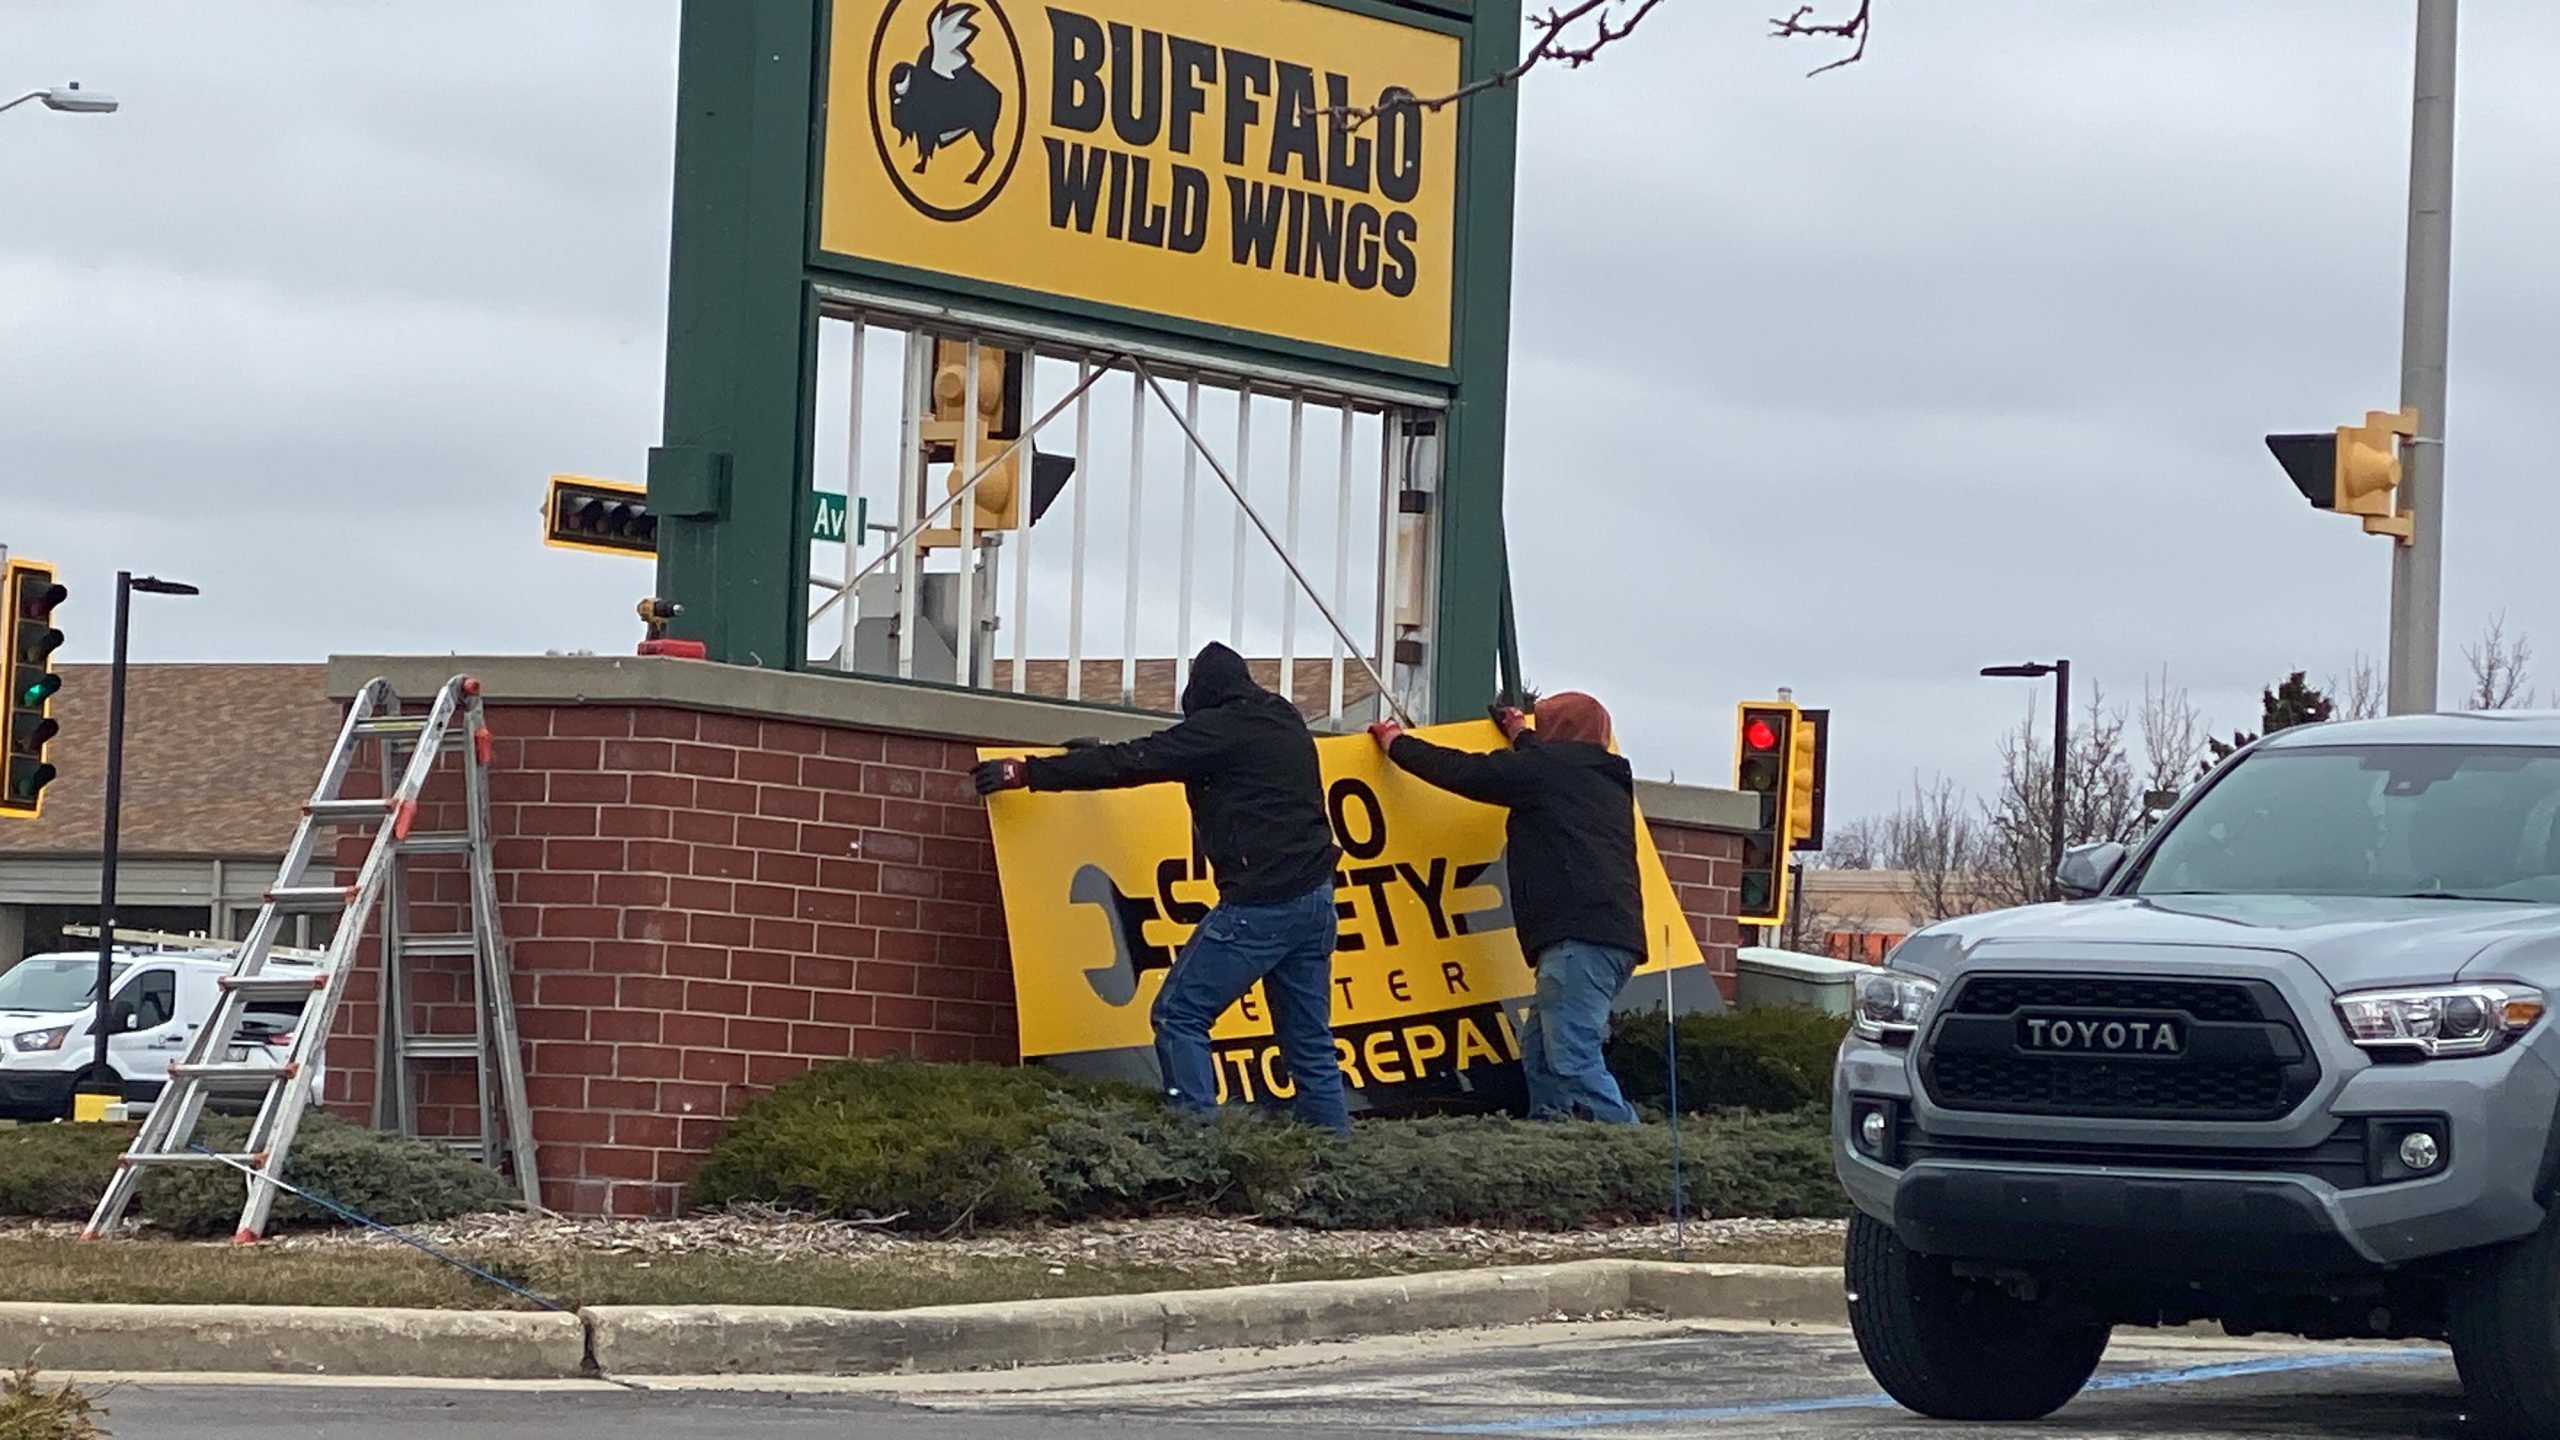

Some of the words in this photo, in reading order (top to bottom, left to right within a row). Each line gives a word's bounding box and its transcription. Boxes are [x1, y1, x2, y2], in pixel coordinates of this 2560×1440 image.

[1045, 7, 1422, 202] BUFFALO
[1042, 137, 1210, 254] WILD
[1226, 175, 1419, 298] WINGS
[813, 497, 846, 537] Av
[1156, 857, 1450, 953] SETY
[1240, 962, 1470, 1021] ETER
[1331, 1008, 1530, 1089] REPAI
[2027, 1019, 2179, 1050] TOYOTA
